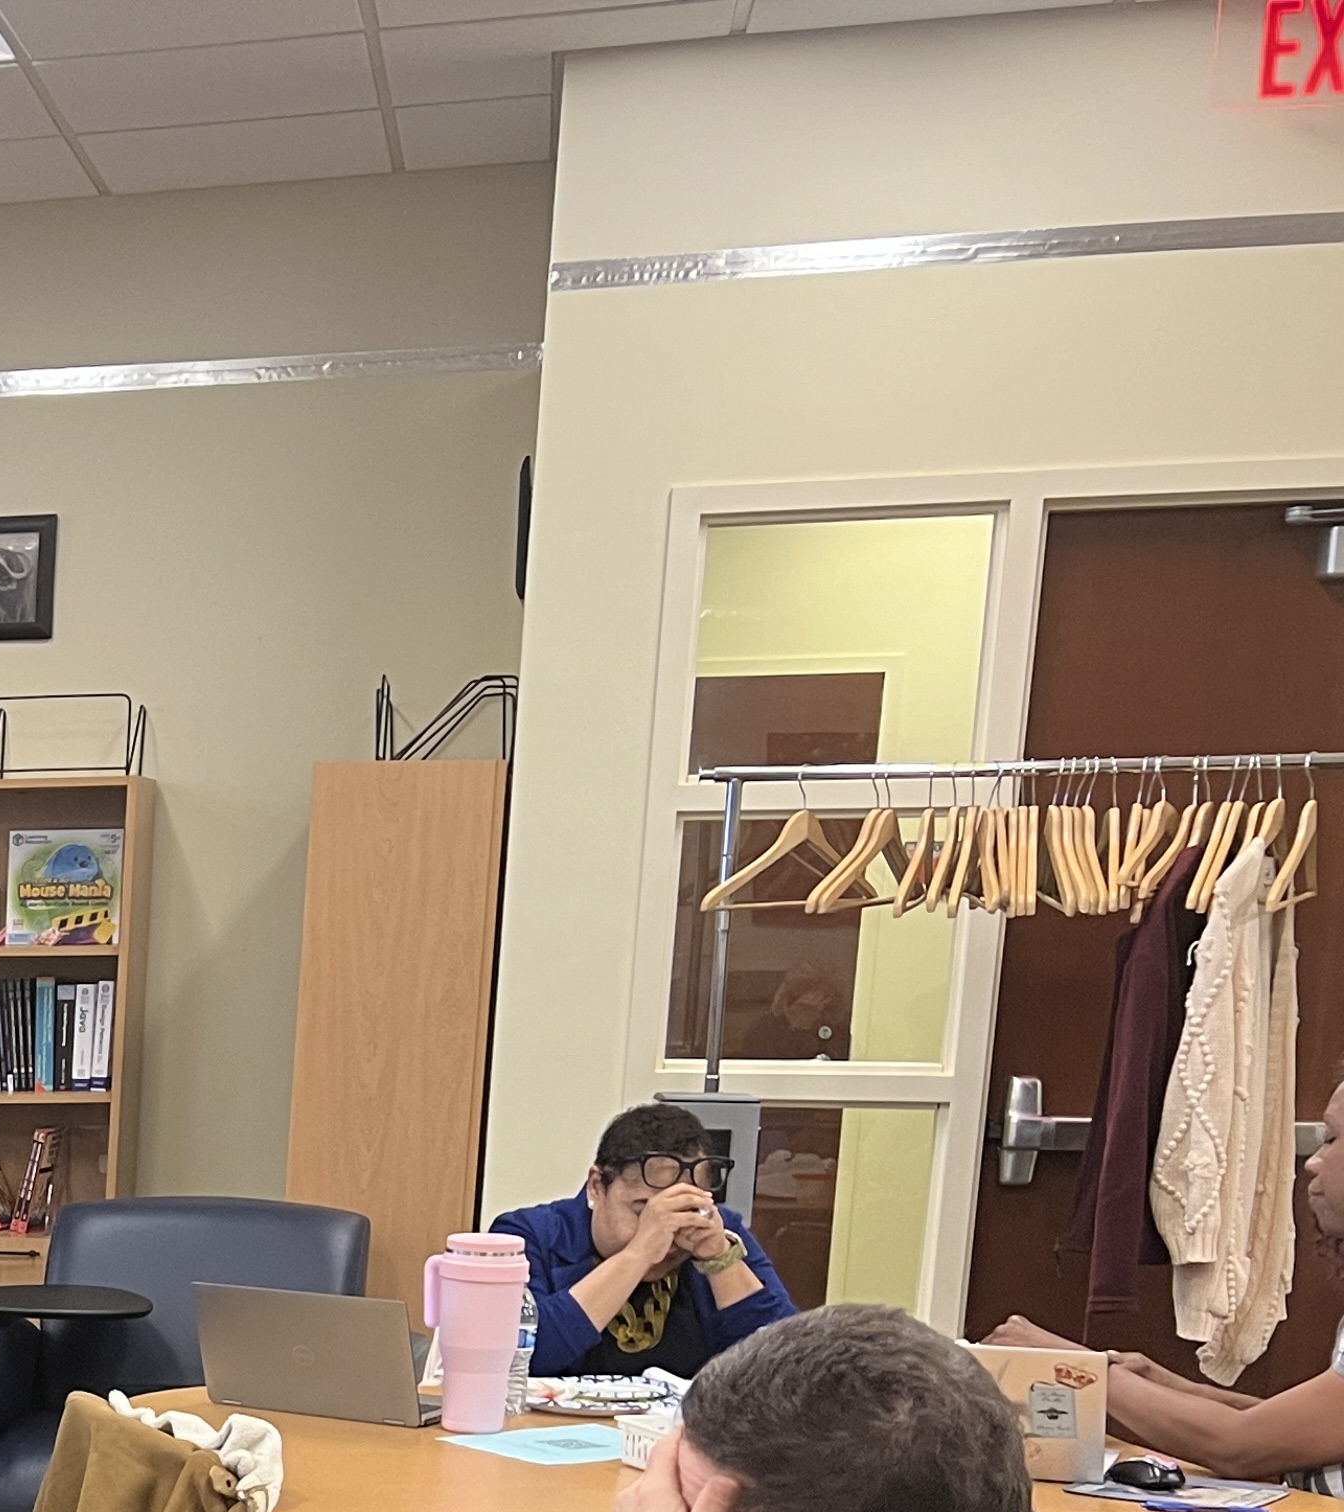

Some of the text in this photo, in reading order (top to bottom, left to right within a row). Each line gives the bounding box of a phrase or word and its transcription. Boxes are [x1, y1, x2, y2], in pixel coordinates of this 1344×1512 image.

[19, 883, 66, 898] Mouse
[68, 878, 112, 898] Mania
[78, 1007, 89, 1033] Java
[99, 1004, 108, 1027] Design
